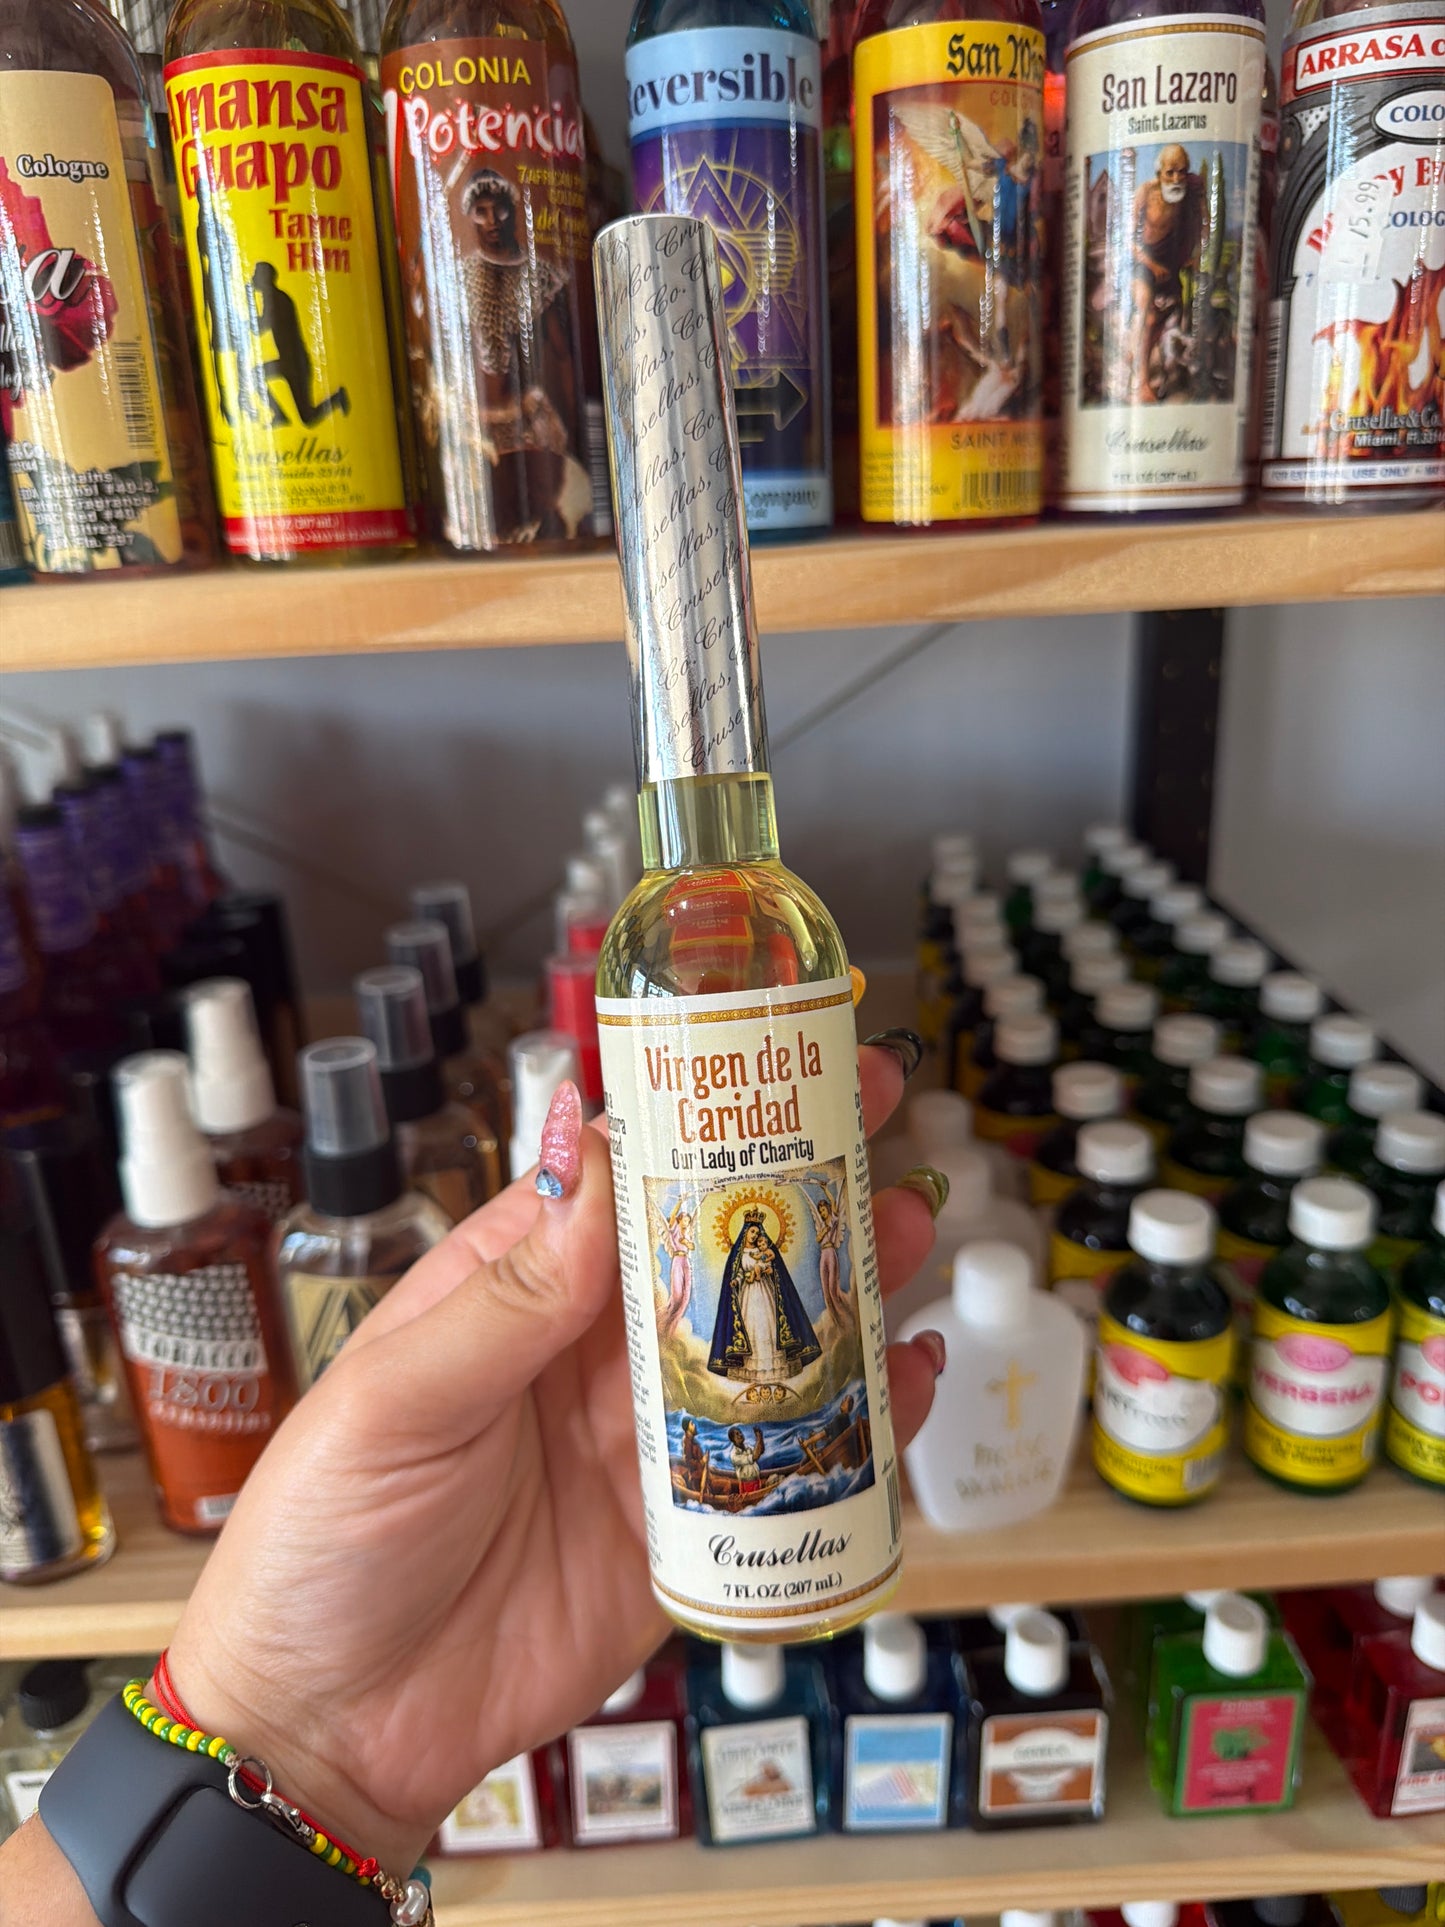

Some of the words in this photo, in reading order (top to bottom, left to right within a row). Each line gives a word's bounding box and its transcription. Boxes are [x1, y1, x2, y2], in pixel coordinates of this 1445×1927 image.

[400, 56, 531, 94] COLONIA
[947, 33, 1002, 77] San
[1300, 33, 1426, 80] ARRASA
[627, 53, 813, 121] eversible
[1102, 73, 1147, 114] San
[1155, 64, 1237, 104] Lazaro
[1128, 115, 1160, 135] Saint
[1162, 113, 1208, 131] Lazarus
[17, 154, 110, 182] Cologne
[181, 141, 342, 204] Guapo
[269, 208, 352, 242] Tame
[644, 1044, 750, 1100] Virgen
[757, 1034, 793, 1085] de
[797, 1030, 823, 1079] la
[677, 1084, 803, 1144] Caridad
[671, 1148, 697, 1170] Our
[700, 1145, 736, 1173] Lady
[739, 1142, 757, 1166] of
[759, 1136, 815, 1165] Charity
[708, 1528, 853, 1568] Crusellas
[723, 1583, 731, 1598] 7
[734, 1583, 756, 1599] FL
[756, 1583, 782, 1598] OZ
[783, 1578, 823, 1599] (207
